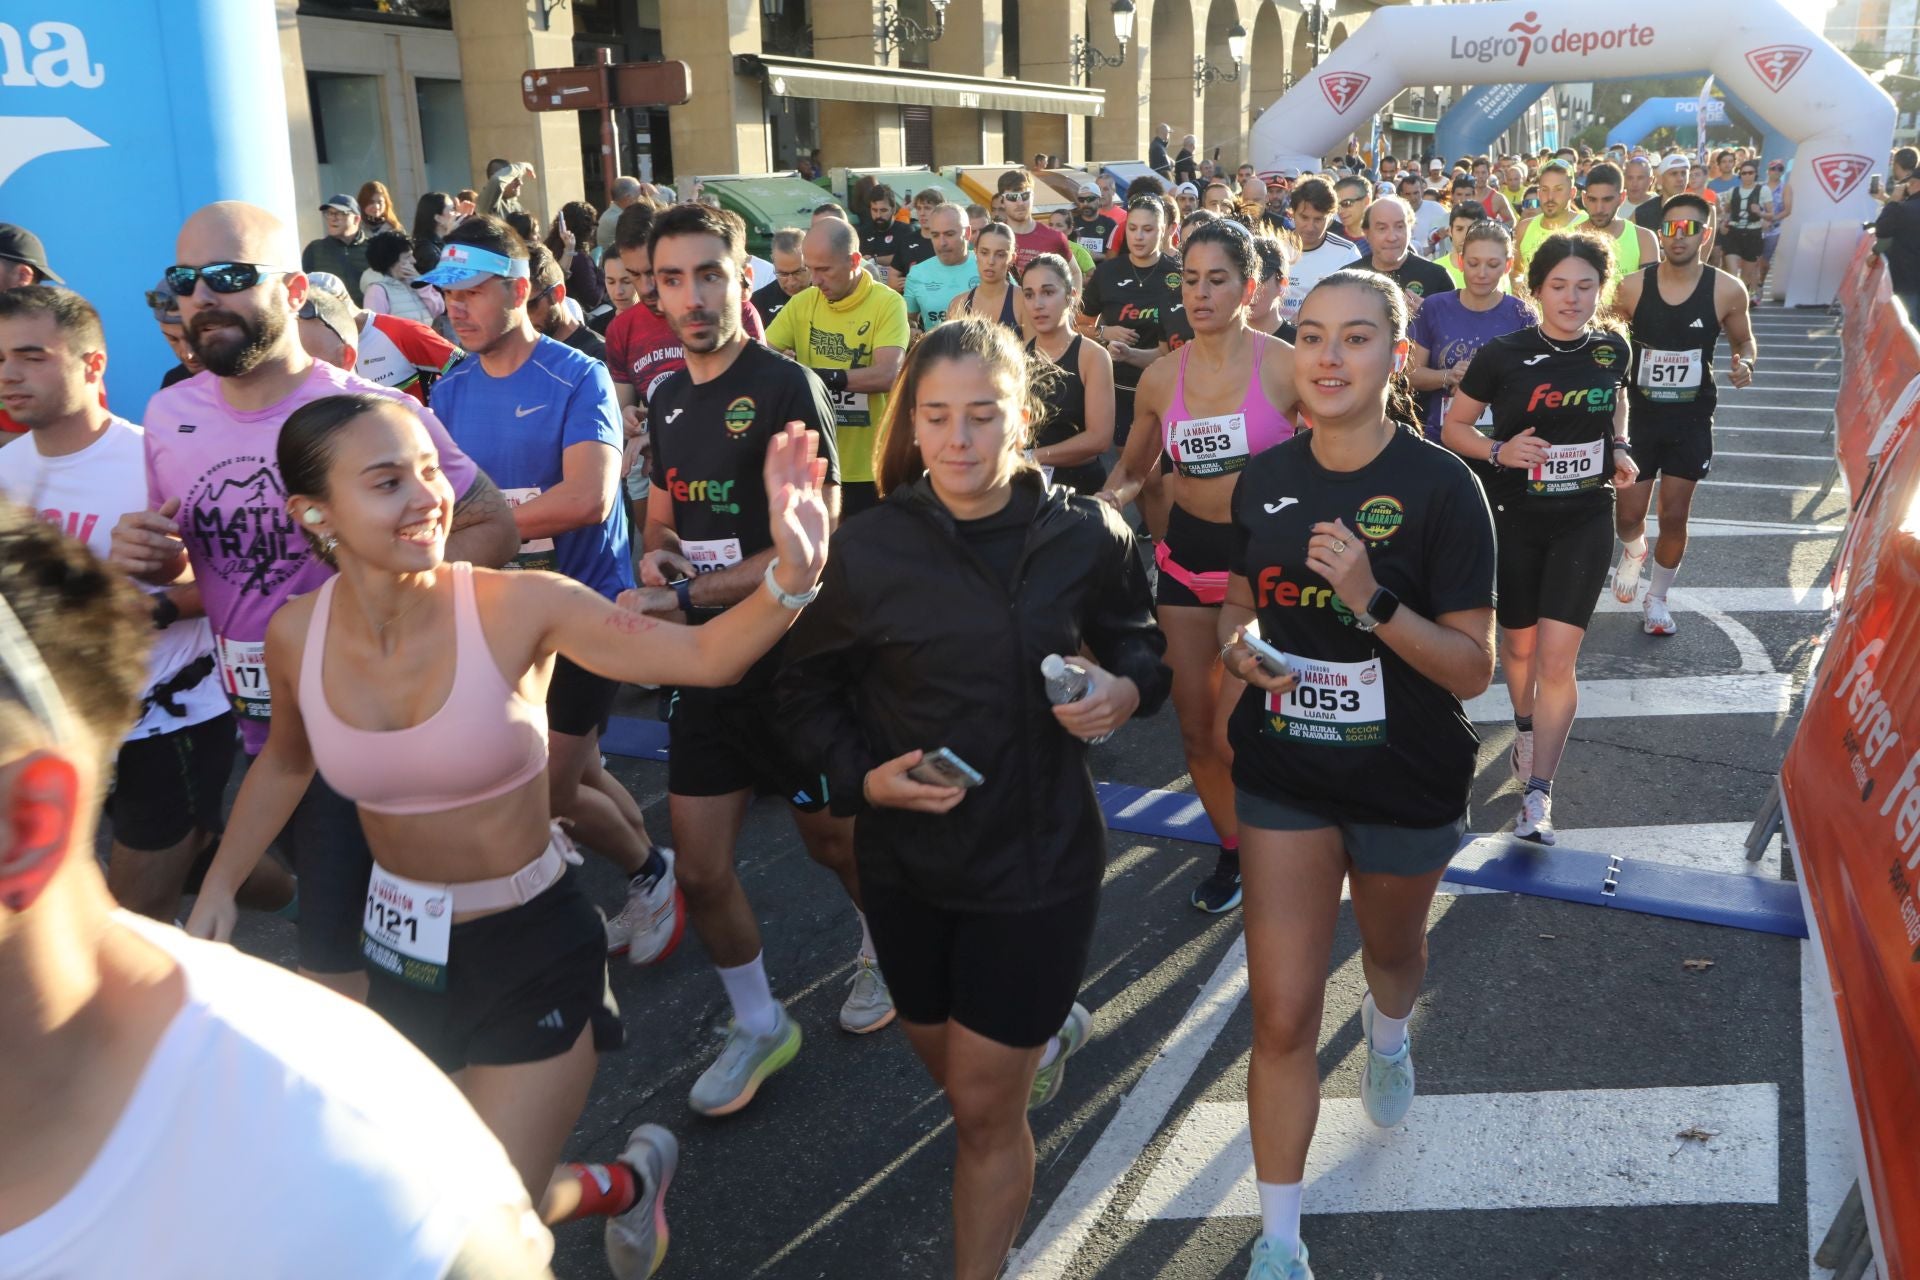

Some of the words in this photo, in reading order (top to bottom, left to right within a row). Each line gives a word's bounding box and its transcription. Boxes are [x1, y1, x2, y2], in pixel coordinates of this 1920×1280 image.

[1551, 24, 1655, 56] deporte
[820, 336, 841, 347] FLY
[816, 345, 846, 356] MAD
[633, 352, 653, 374] CURSA
[653, 348, 664, 362] DE
[1652, 364, 1689, 383] 517
[1587, 404, 1609, 413] sport
[1183, 427, 1192, 437] LA
[1192, 424, 1222, 437] MARATÓN
[1180, 434, 1231, 455] 1853
[1550, 451, 1558, 460] LA
[1559, 449, 1587, 459] MARATÓN
[1545, 458, 1591, 475] 1810
[1355, 511, 1366, 522] LA
[1367, 513, 1403, 525] MARATÓN
[198, 531, 301, 560] TRAIL
[1304, 670, 1349, 687] MARATÓN
[1290, 686, 1360, 712] 1053
[1304, 710, 1337, 720] LUANA
[1289, 722, 1309, 732] CAJA
[1309, 724, 1339, 734] RURAL
[1345, 725, 1379, 734] ACCIÓN
[1289, 728, 1301, 738] DE
[1302, 731, 1343, 741] NAVARRA
[1850, 753, 1868, 790] center
[367, 894, 418, 944] 1121
